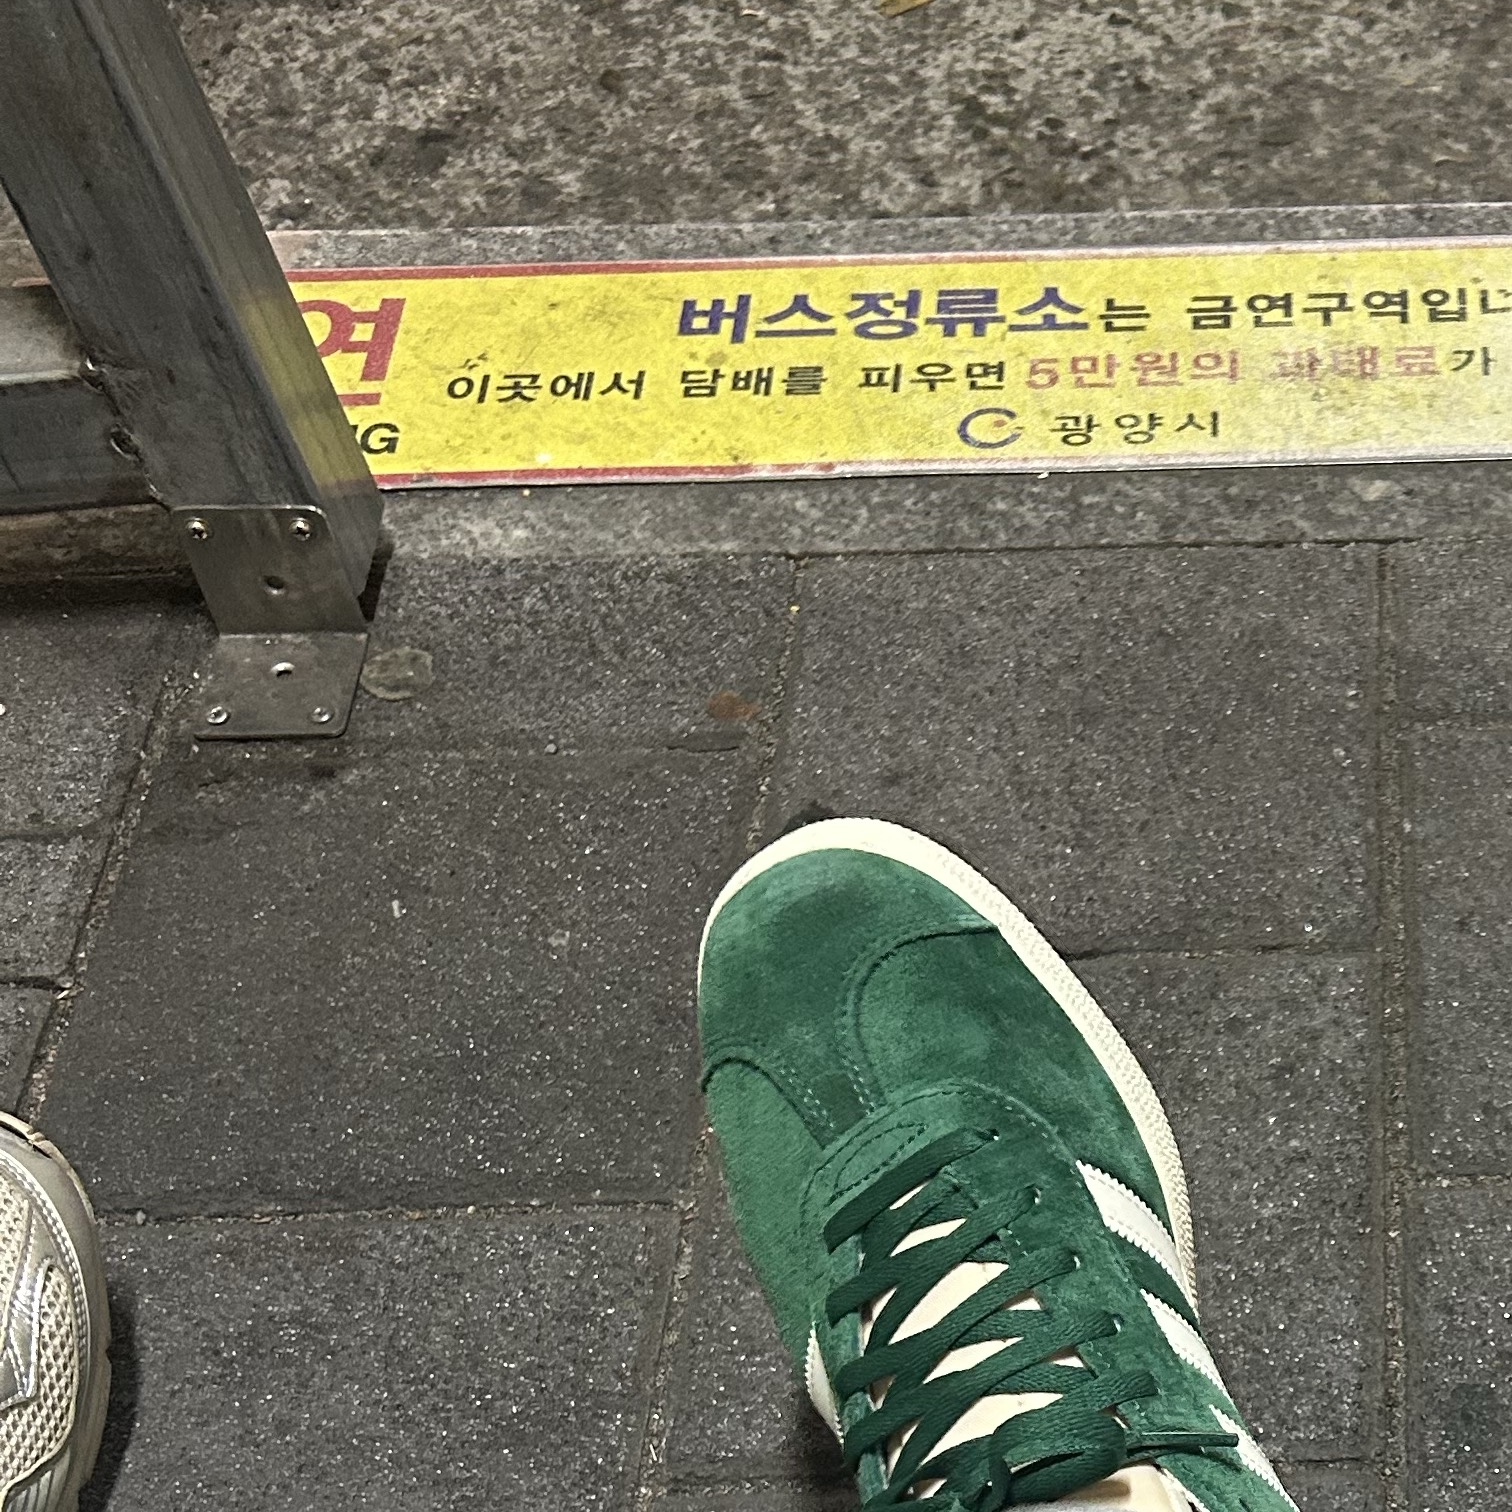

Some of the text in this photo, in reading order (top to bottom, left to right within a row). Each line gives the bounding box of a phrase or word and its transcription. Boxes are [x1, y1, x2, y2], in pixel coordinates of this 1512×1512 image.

[677, 286, 1152, 344] 버스정류소는
[446, 370, 647, 404] 이곳에서
[680, 364, 828, 399] 담배를
[859, 360, 1006, 393] 피우면
[1025, 349, 1243, 390] 5만원의
[1048, 411, 1220, 446] 광양시
